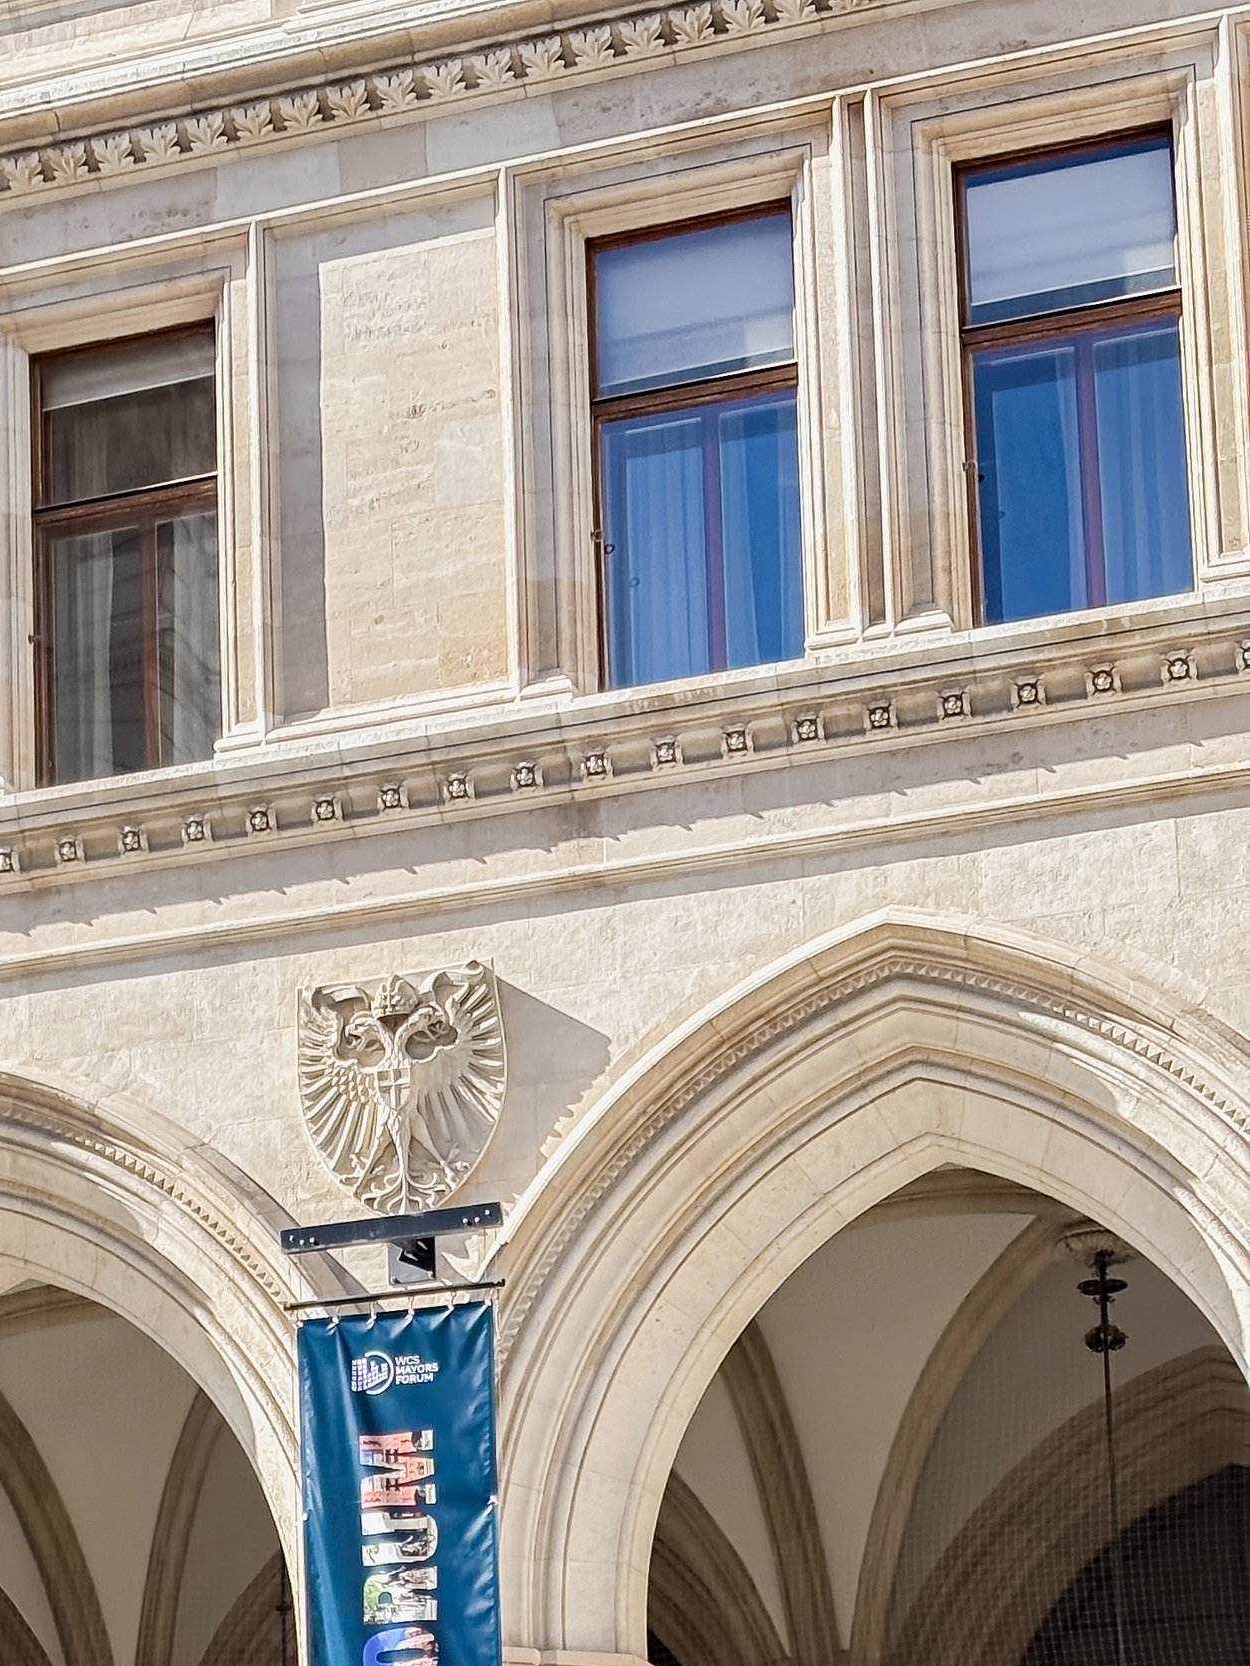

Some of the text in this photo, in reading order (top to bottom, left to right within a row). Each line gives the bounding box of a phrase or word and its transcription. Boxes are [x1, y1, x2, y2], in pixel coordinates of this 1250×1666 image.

[395, 1355, 420, 1365] WCS
[395, 1363, 439, 1374] MAYORS
[395, 1373, 433, 1385] FORUM
